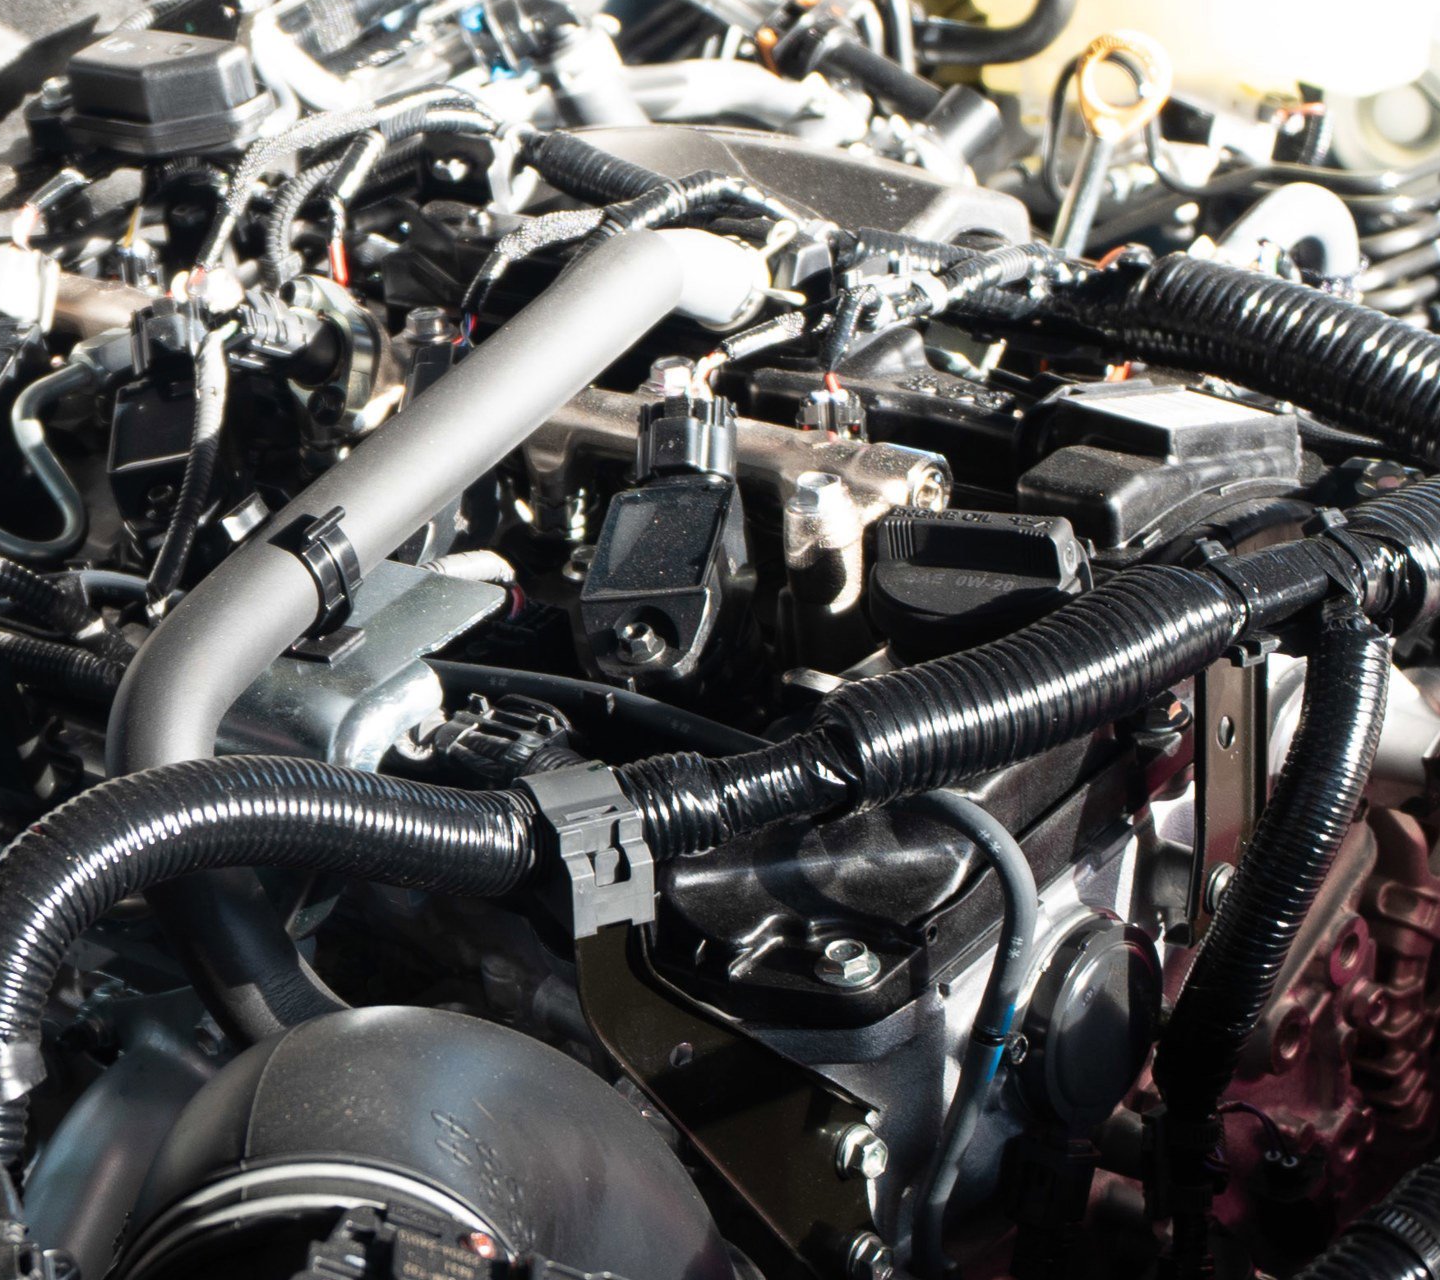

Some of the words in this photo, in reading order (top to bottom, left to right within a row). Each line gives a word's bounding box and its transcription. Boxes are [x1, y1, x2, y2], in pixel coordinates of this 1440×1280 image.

[891, 507, 958, 521] ENGINE
[961, 512, 994, 524] OIL
[903, 572, 946, 585] SAE
[954, 575, 1016, 592] 0W-20
